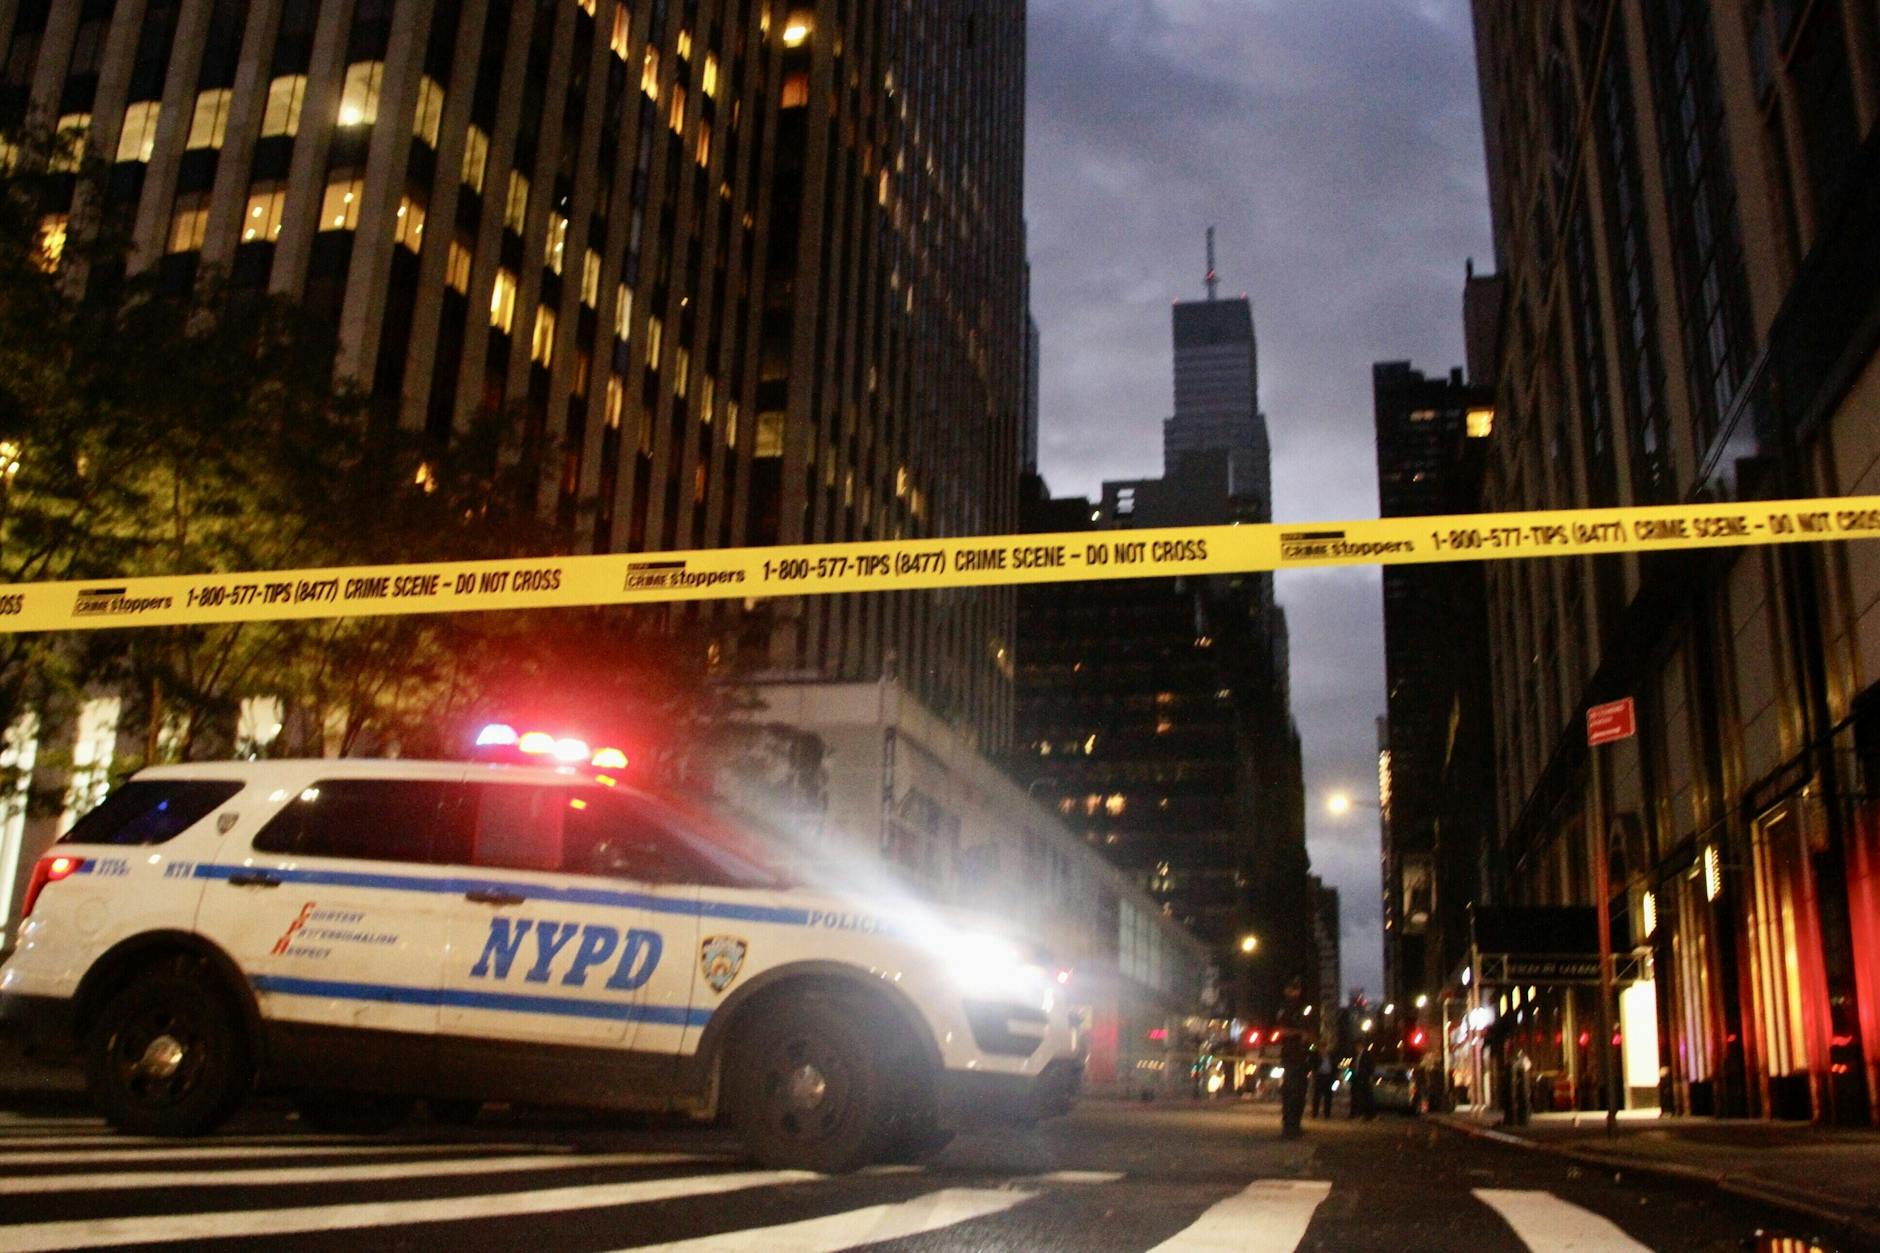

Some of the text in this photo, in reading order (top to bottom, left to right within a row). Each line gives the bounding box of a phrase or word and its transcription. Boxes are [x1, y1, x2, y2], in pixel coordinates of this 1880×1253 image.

[1431, 526, 1568, 551] 1-800-577-TIPS
[1571, 520, 1628, 545] (8477)
[1633, 518, 1690, 540] CRIME
[1692, 515, 1751, 538] SCENE
[1768, 513, 1794, 535] DO
[1796, 511, 1832, 533] NOT
[670, 568, 746, 588] stoppers
[762, 553, 891, 582] 1-800-577-TIPS
[894, 549, 946, 577] (8477)
[954, 547, 1008, 572] CRIME
[1012, 545, 1066, 570] SCENE
[1085, 543, 1109, 566] DO
[1113, 541, 1147, 565] NOT
[1151, 538, 1208, 563] CROSS
[111, 596, 173, 614] stoppers
[186, 582, 292, 609] 1-800-577-TIPS
[293, 577, 339, 605] (8477)
[343, 576, 389, 600] CRIME
[393, 574, 441, 598] SCENE
[455, 572, 476, 595] DO
[479, 570, 510, 593] NOT
[512, 568, 562, 592] CROSS
[470, 916, 662, 990] NYPD
